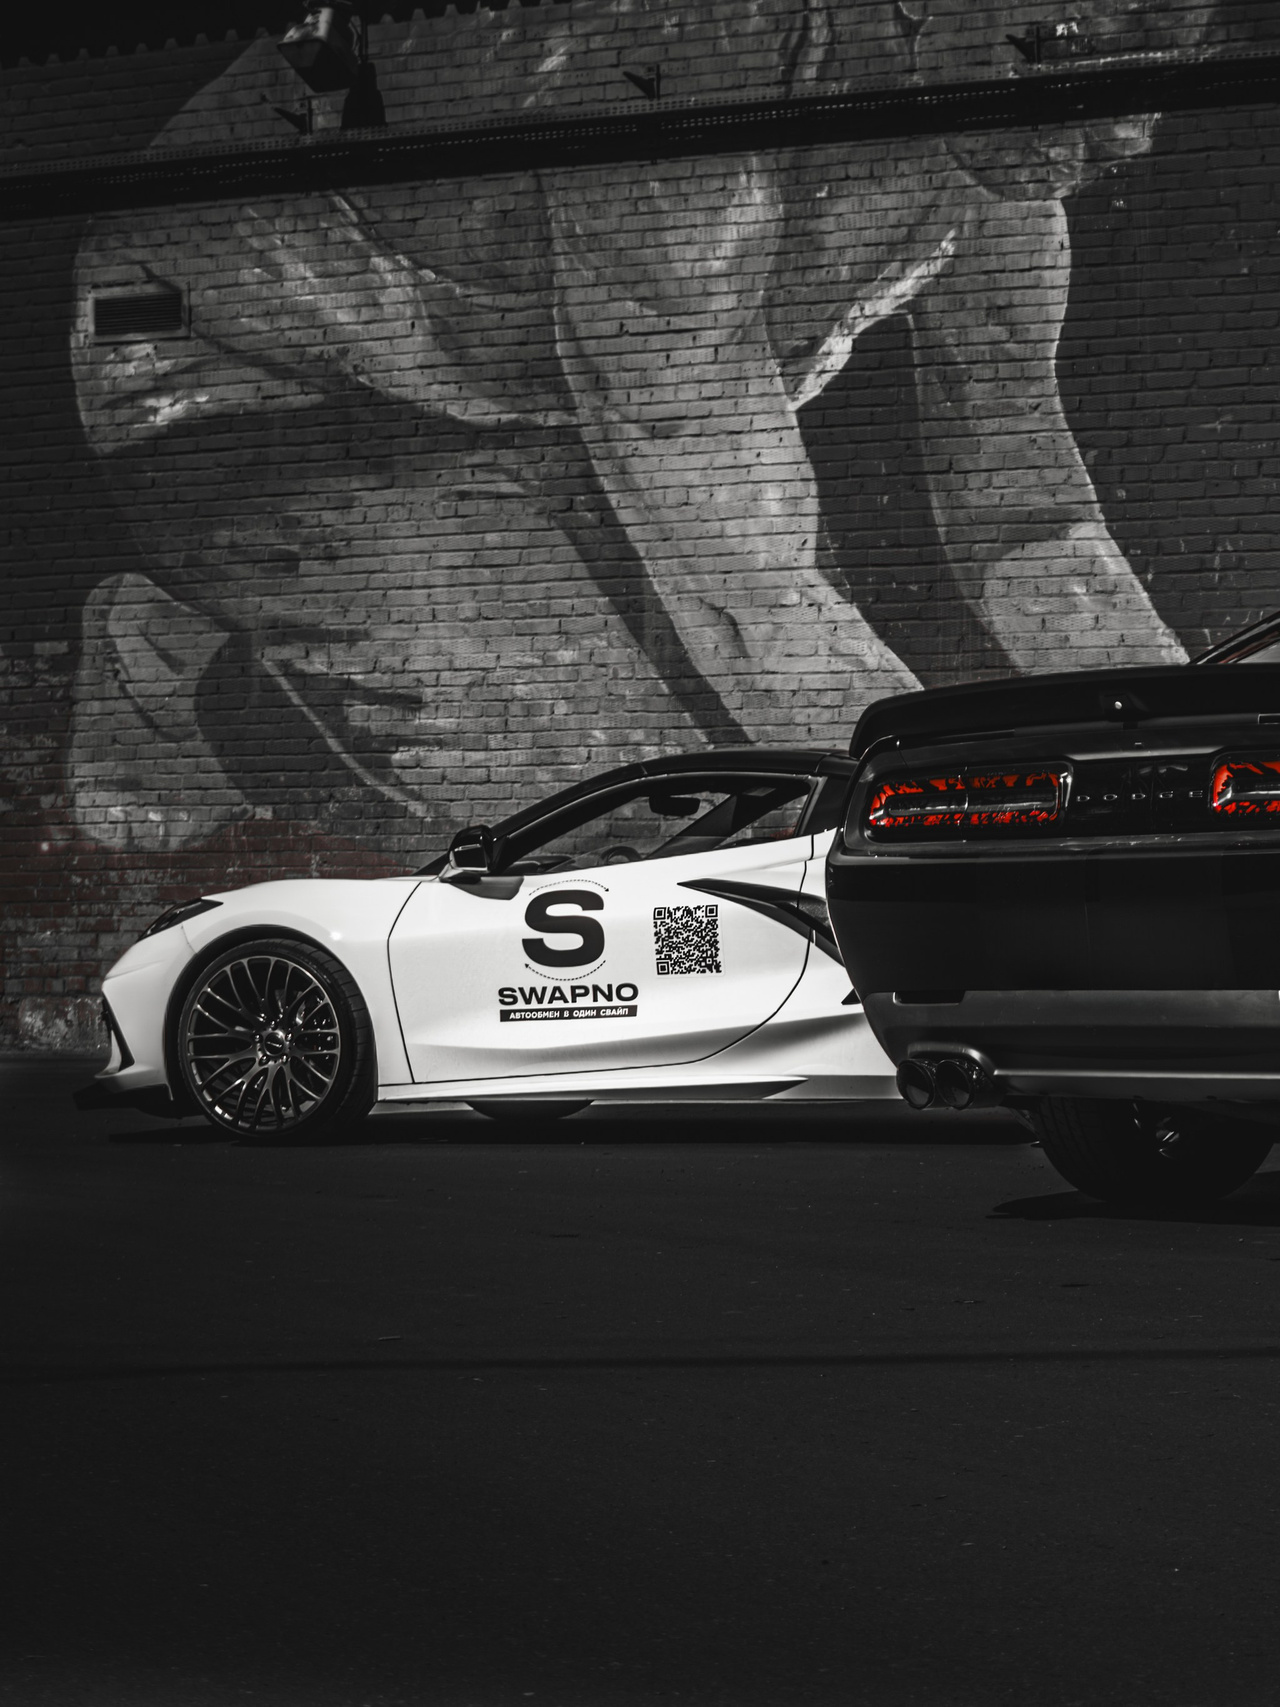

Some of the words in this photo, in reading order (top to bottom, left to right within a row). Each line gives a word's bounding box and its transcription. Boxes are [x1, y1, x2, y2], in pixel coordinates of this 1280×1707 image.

[1076, 790, 1203, 802] DODGE
[521, 889, 605, 968] S
[498, 982, 639, 1006] SWAPNO
[509, 1010, 560, 1019] АВТООБМЕН
[573, 1009, 597, 1018] ОДИН
[600, 1007, 629, 1016] СВАЙП
